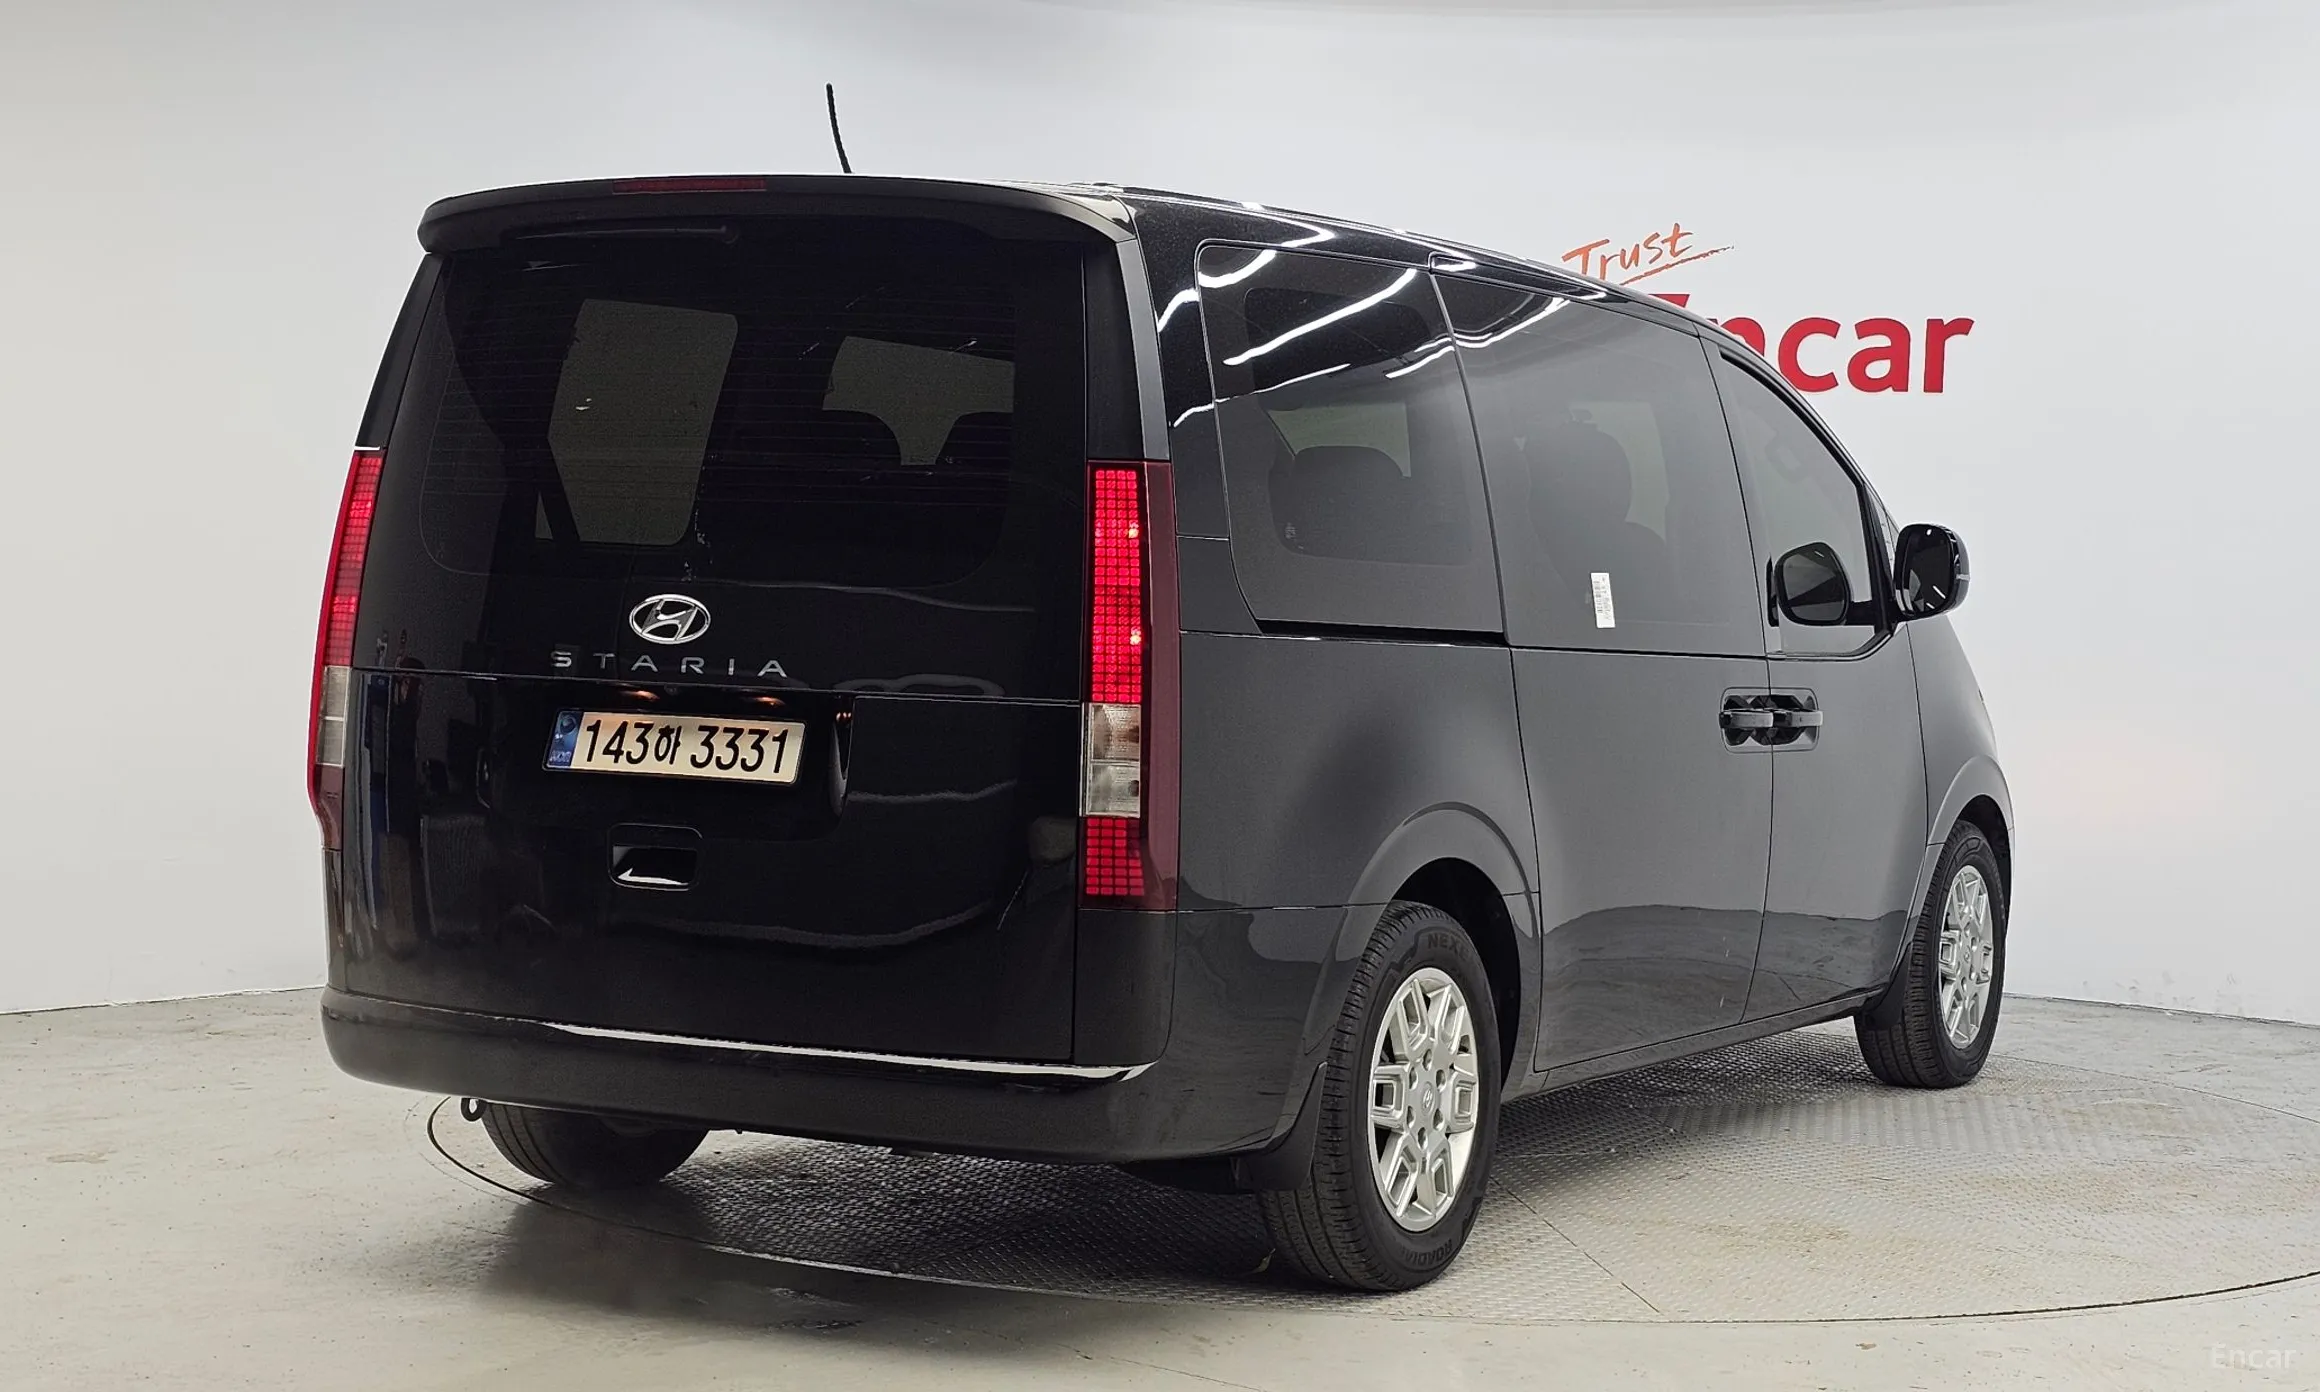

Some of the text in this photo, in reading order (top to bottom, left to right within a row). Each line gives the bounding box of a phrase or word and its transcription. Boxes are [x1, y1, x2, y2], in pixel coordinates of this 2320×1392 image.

[1562, 223, 1694, 281] Trust
[1648, 293, 1975, 393] car
[550, 650, 788, 678] STARIA
[586, 719, 789, 774] 143하 3331
